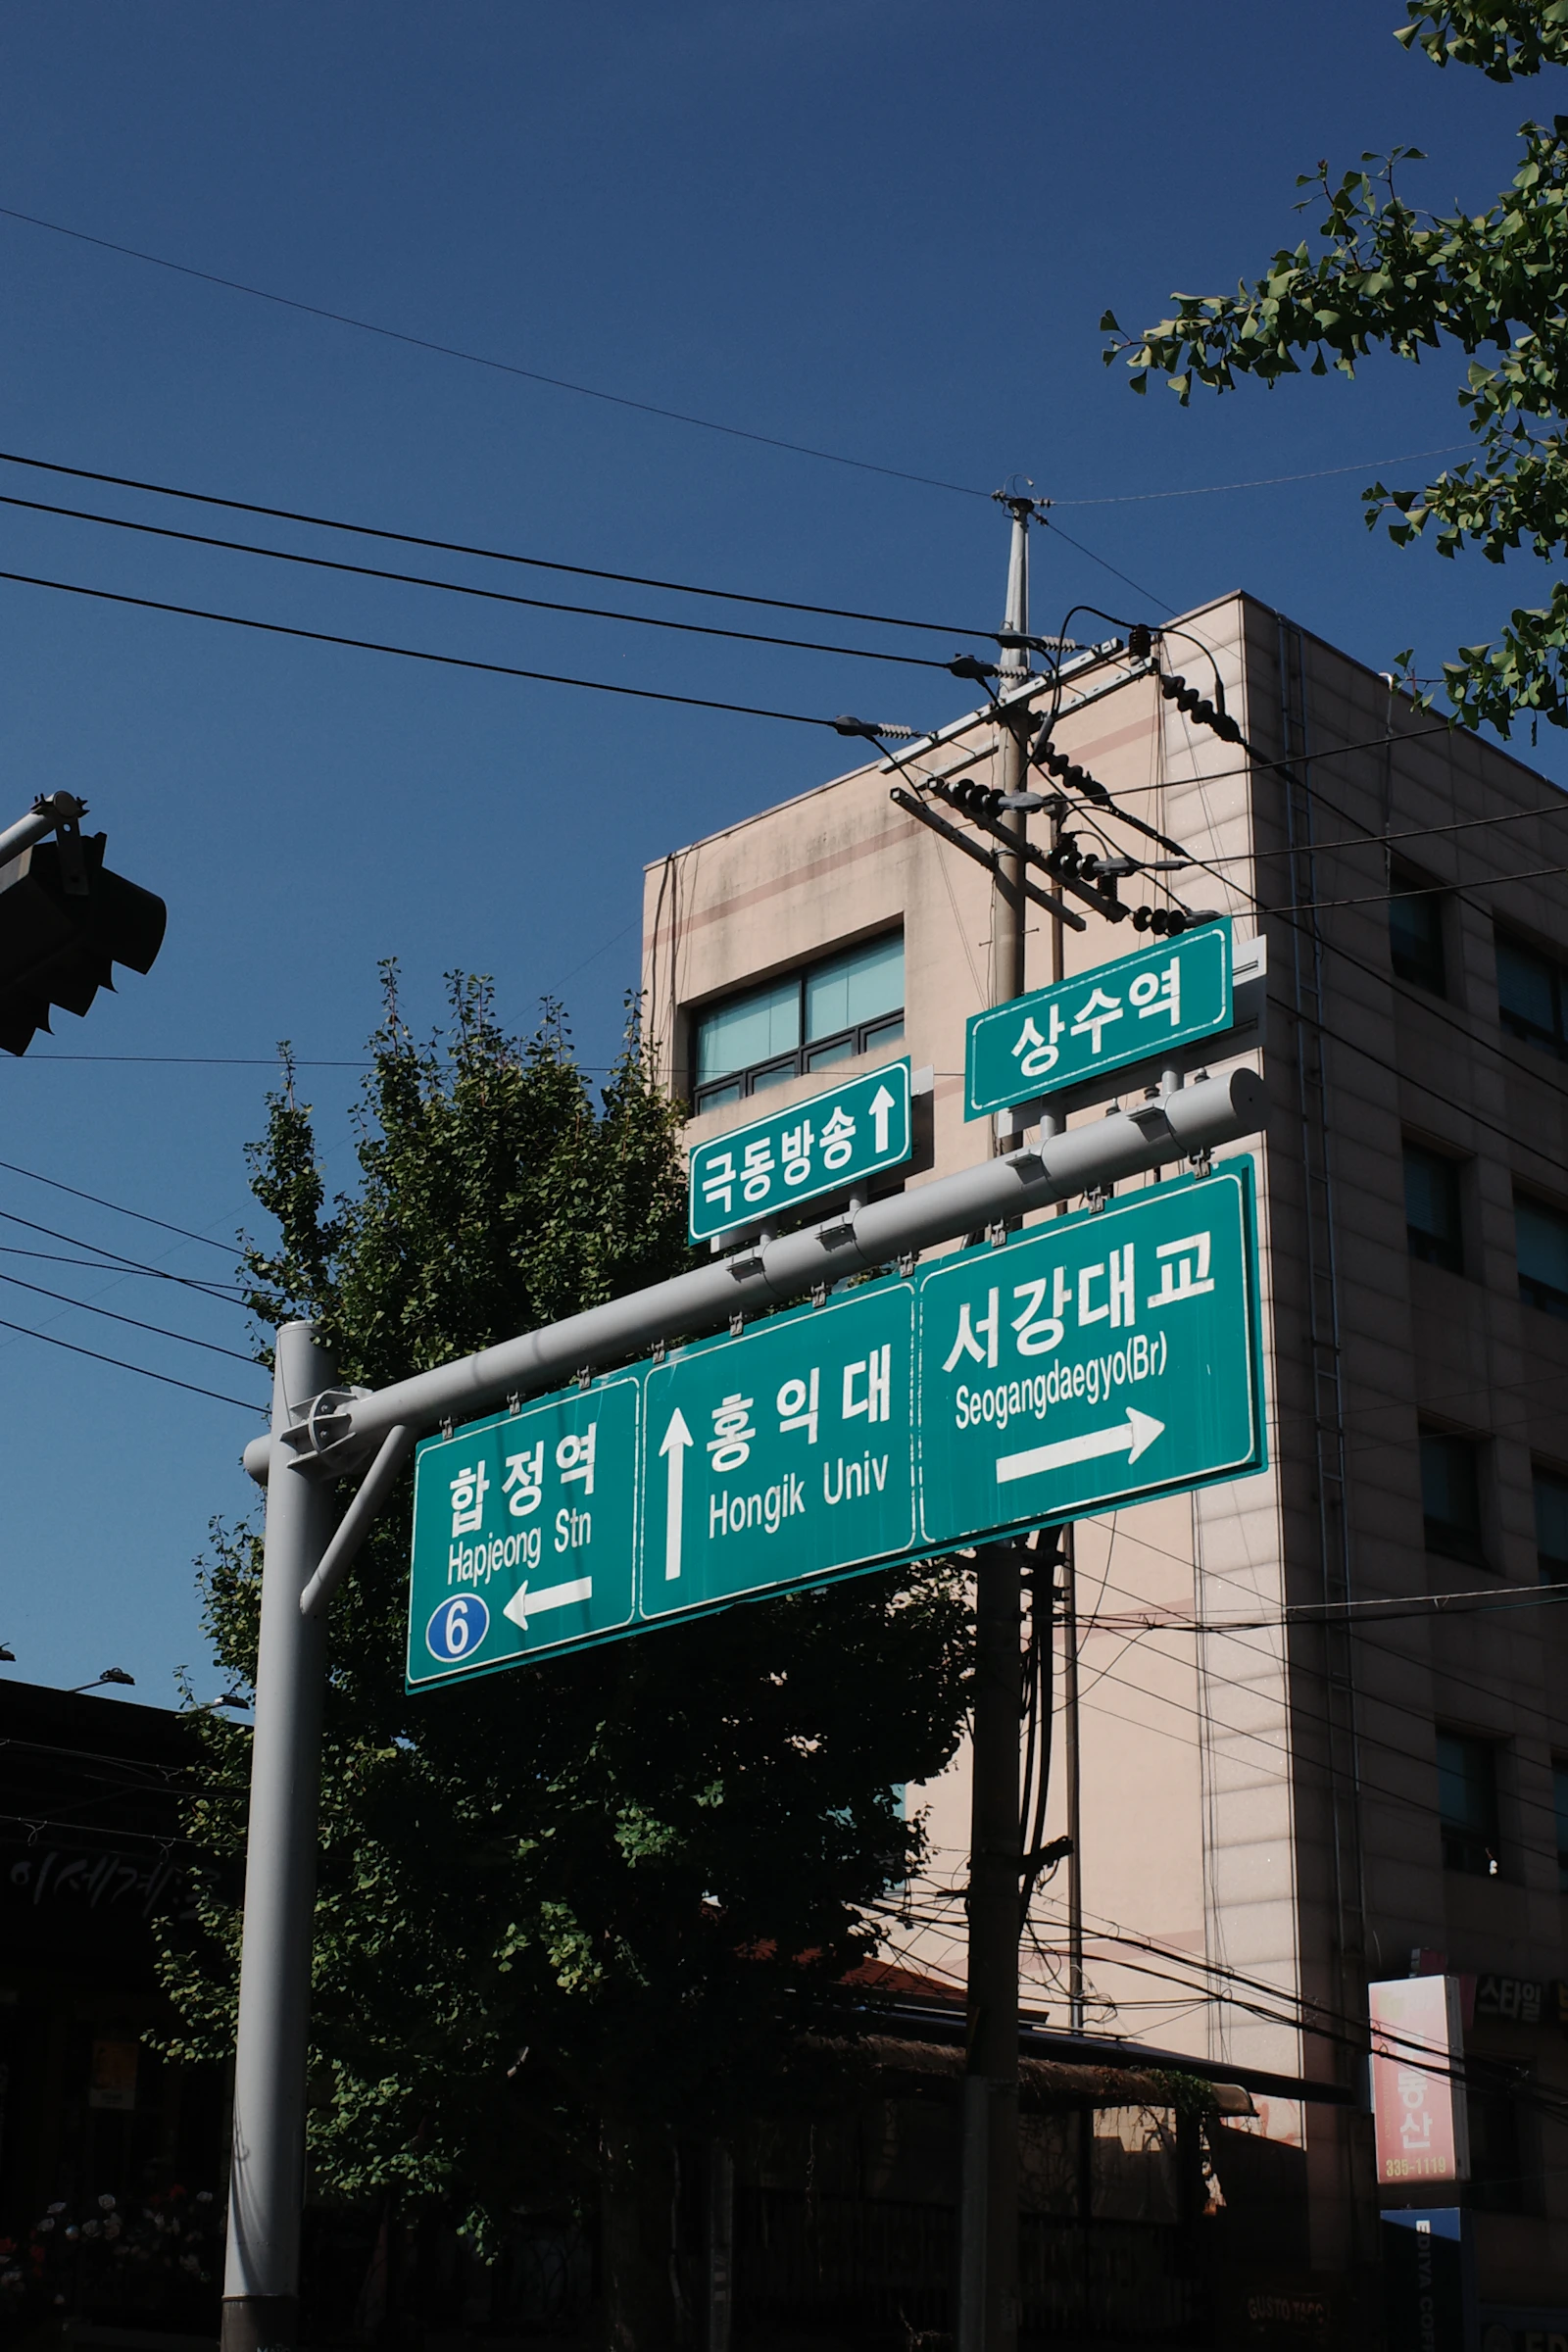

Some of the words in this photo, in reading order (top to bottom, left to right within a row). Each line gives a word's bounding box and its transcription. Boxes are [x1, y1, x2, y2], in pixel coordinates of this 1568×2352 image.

[1010, 956, 1181, 1077] 상수역
[702, 1106, 857, 1213] 극동방송
[942, 1231, 1215, 1373] 서강대교
[707, 1344, 891, 1473] 홍익대
[956, 1330, 1167, 1430] Seogangdaegyo(Br)
[449, 1422, 597, 1539] 합정역
[709, 1472, 806, 1540] Hongik
[823, 1451, 889, 1505] Univ
[447, 1526, 541, 1588] Hapjeong
[554, 1507, 592, 1553] Stn
[445, 1599, 469, 1656] 6
[1477, 1975, 1542, 2024] 스타일
[1386, 2157, 1446, 2178] 335-1119
[1415, 2219, 1434, 2289] EDIYA
[1248, 2295, 1292, 2322] GUSTO
